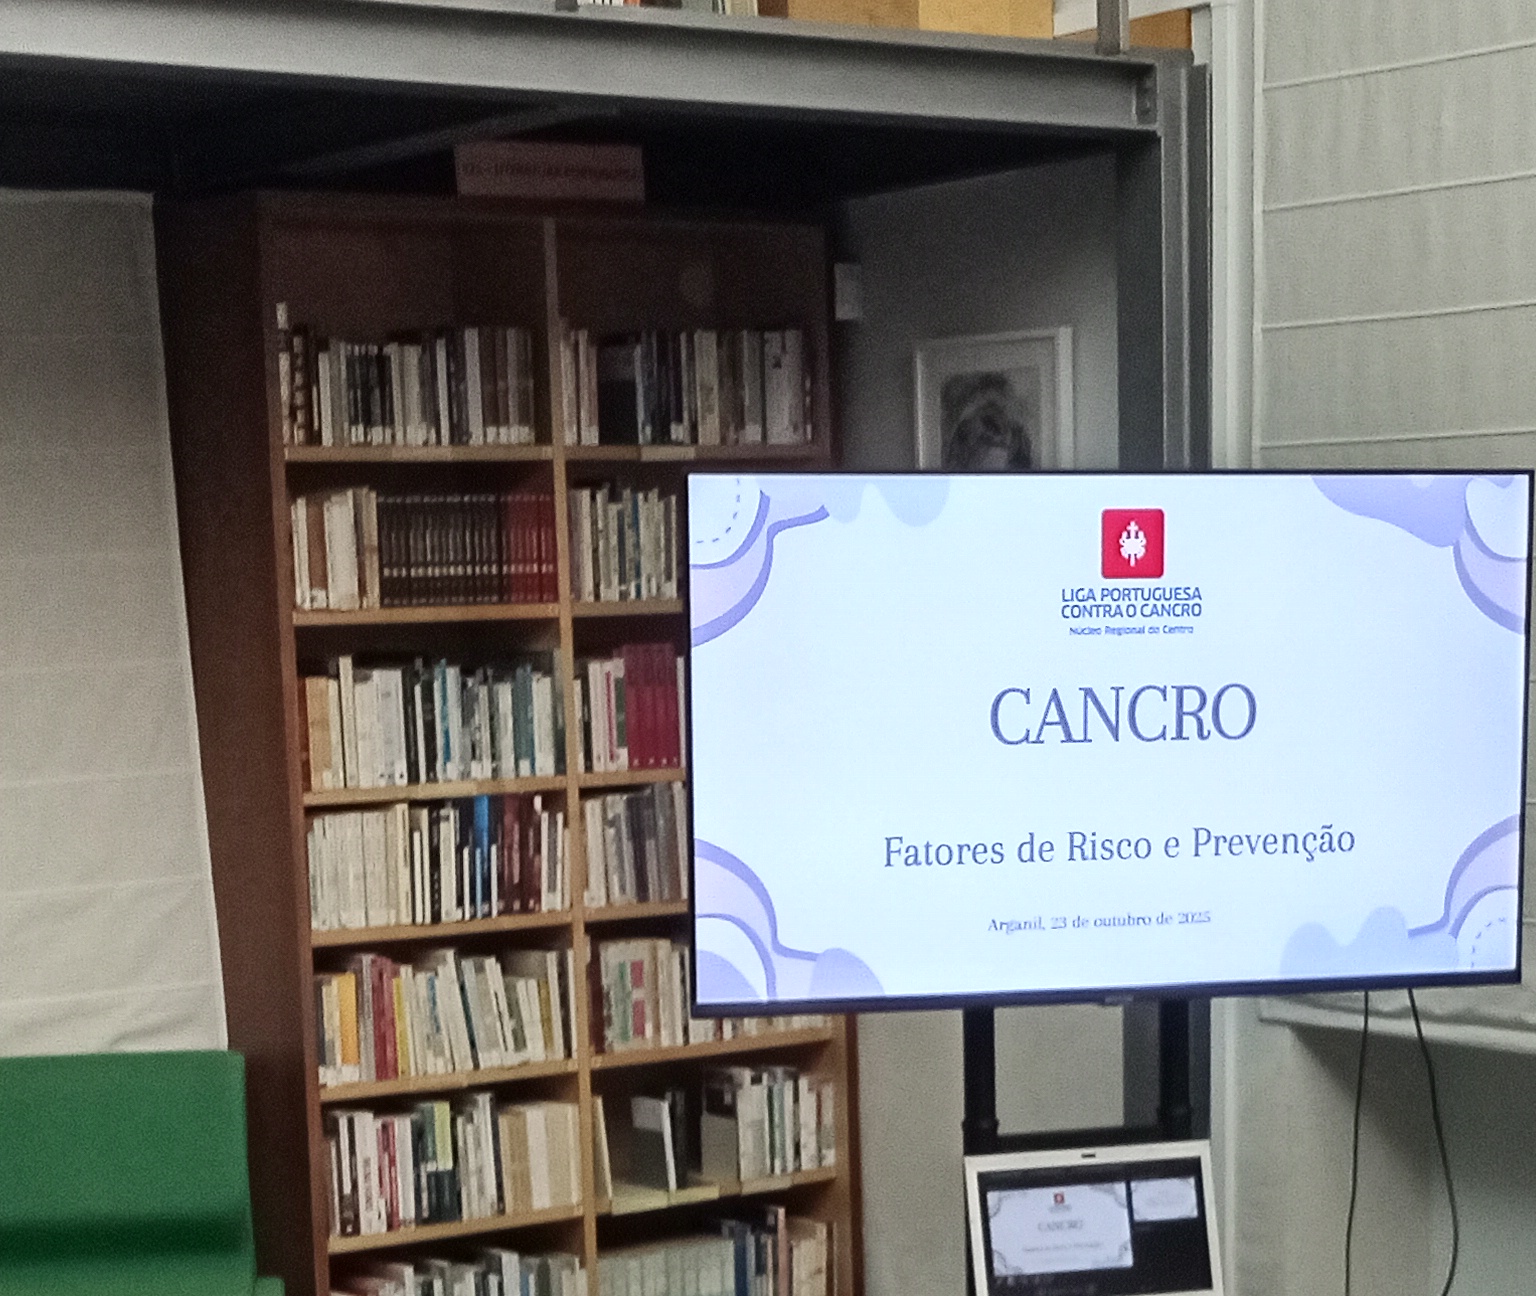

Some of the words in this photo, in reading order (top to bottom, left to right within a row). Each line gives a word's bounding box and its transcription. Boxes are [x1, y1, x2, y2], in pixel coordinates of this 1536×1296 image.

[1061, 587, 1096, 602] LIGA
[1100, 587, 1202, 602] PORTUGUESA
[1061, 604, 1123, 618] CONTRA
[1126, 603, 1137, 618] O
[1140, 603, 1202, 618] CANCRO
[990, 683, 1257, 746] CANCRO
[884, 836, 1005, 868] Fatores
[1017, 831, 1055, 863] de
[1067, 831, 1152, 862] Risco
[1164, 837, 1180, 858] e
[1193, 823, 1356, 863] Prevenção
[988, 917, 1046, 935] Arganil,
[1051, 916, 1067, 929] 23
[1072, 915, 1089, 928] de
[1094, 913, 1151, 927] outubro
[1156, 912, 1173, 925] de
[1178, 911, 1211, 924] 2025
